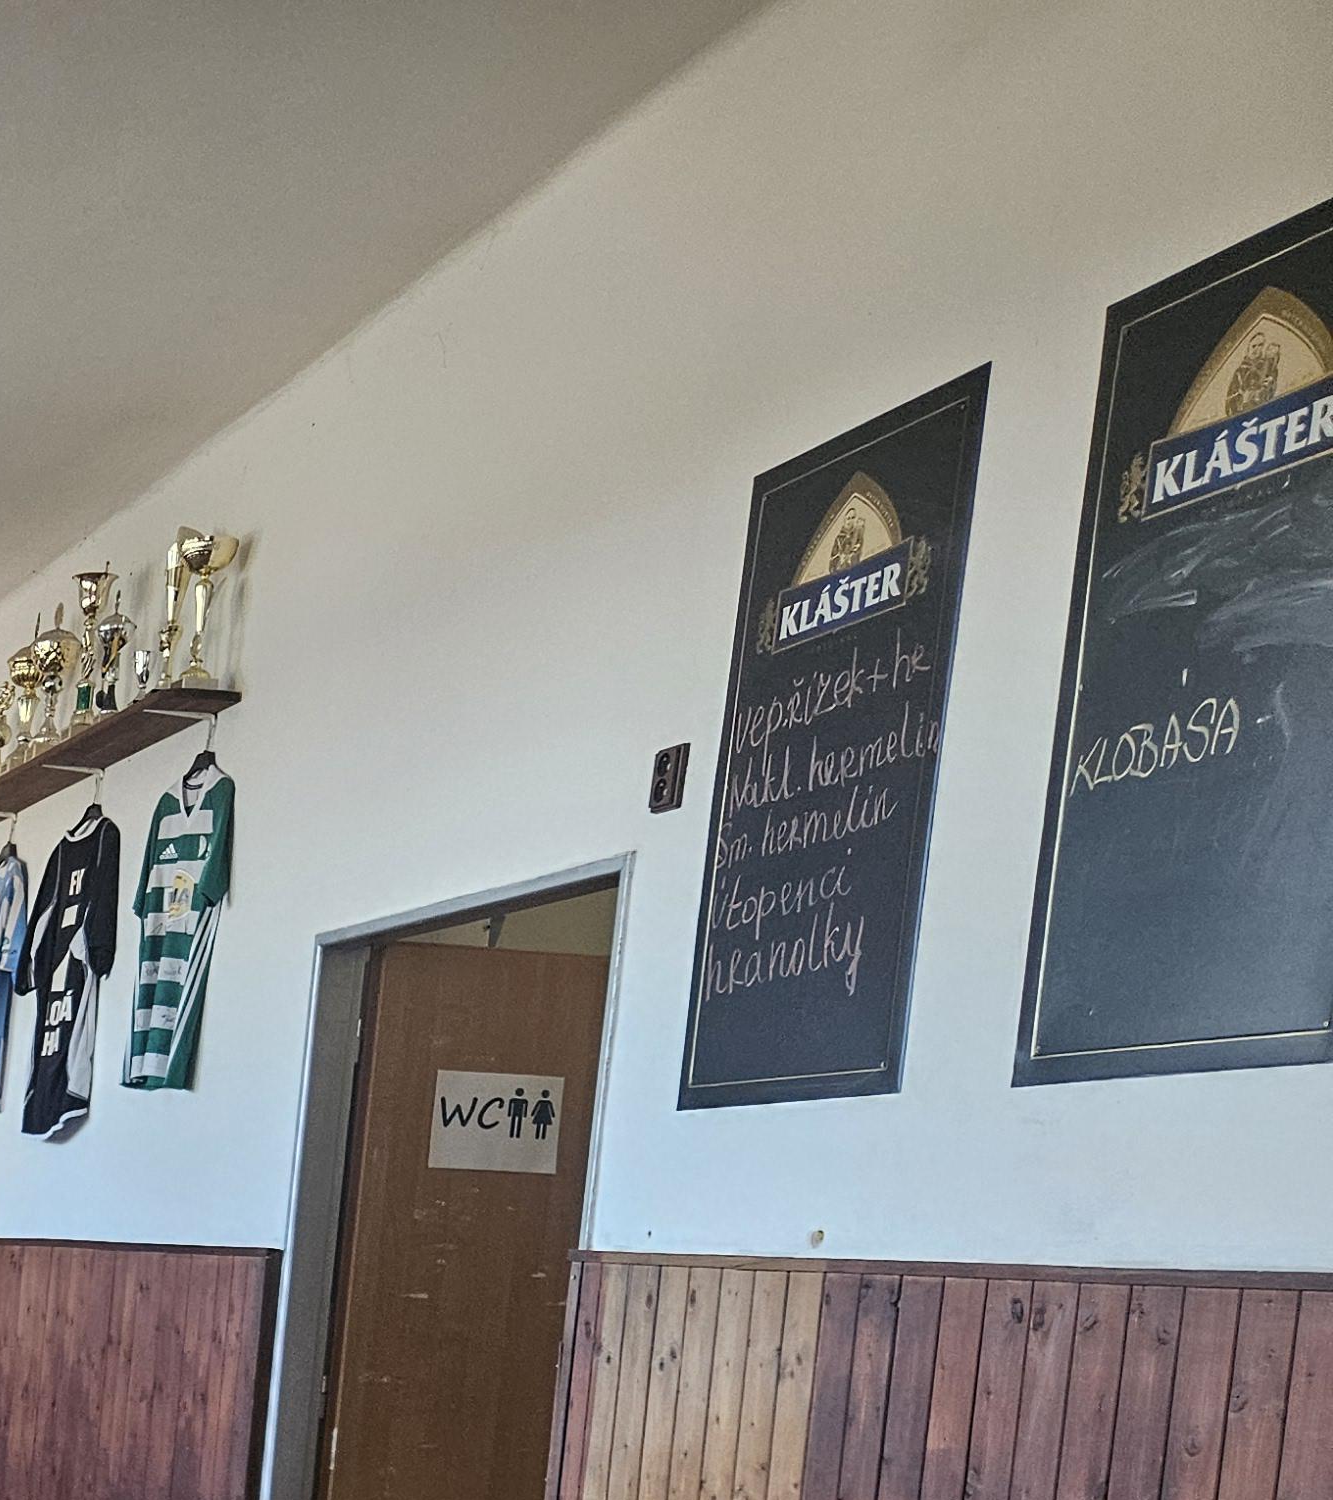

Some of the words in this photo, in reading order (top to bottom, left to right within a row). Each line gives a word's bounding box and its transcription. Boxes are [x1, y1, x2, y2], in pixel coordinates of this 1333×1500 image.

[1151, 394, 1333, 503] KLÁŠTER
[779, 562, 902, 641] KLÁŠTER
[440, 1096, 505, 1130] WC
